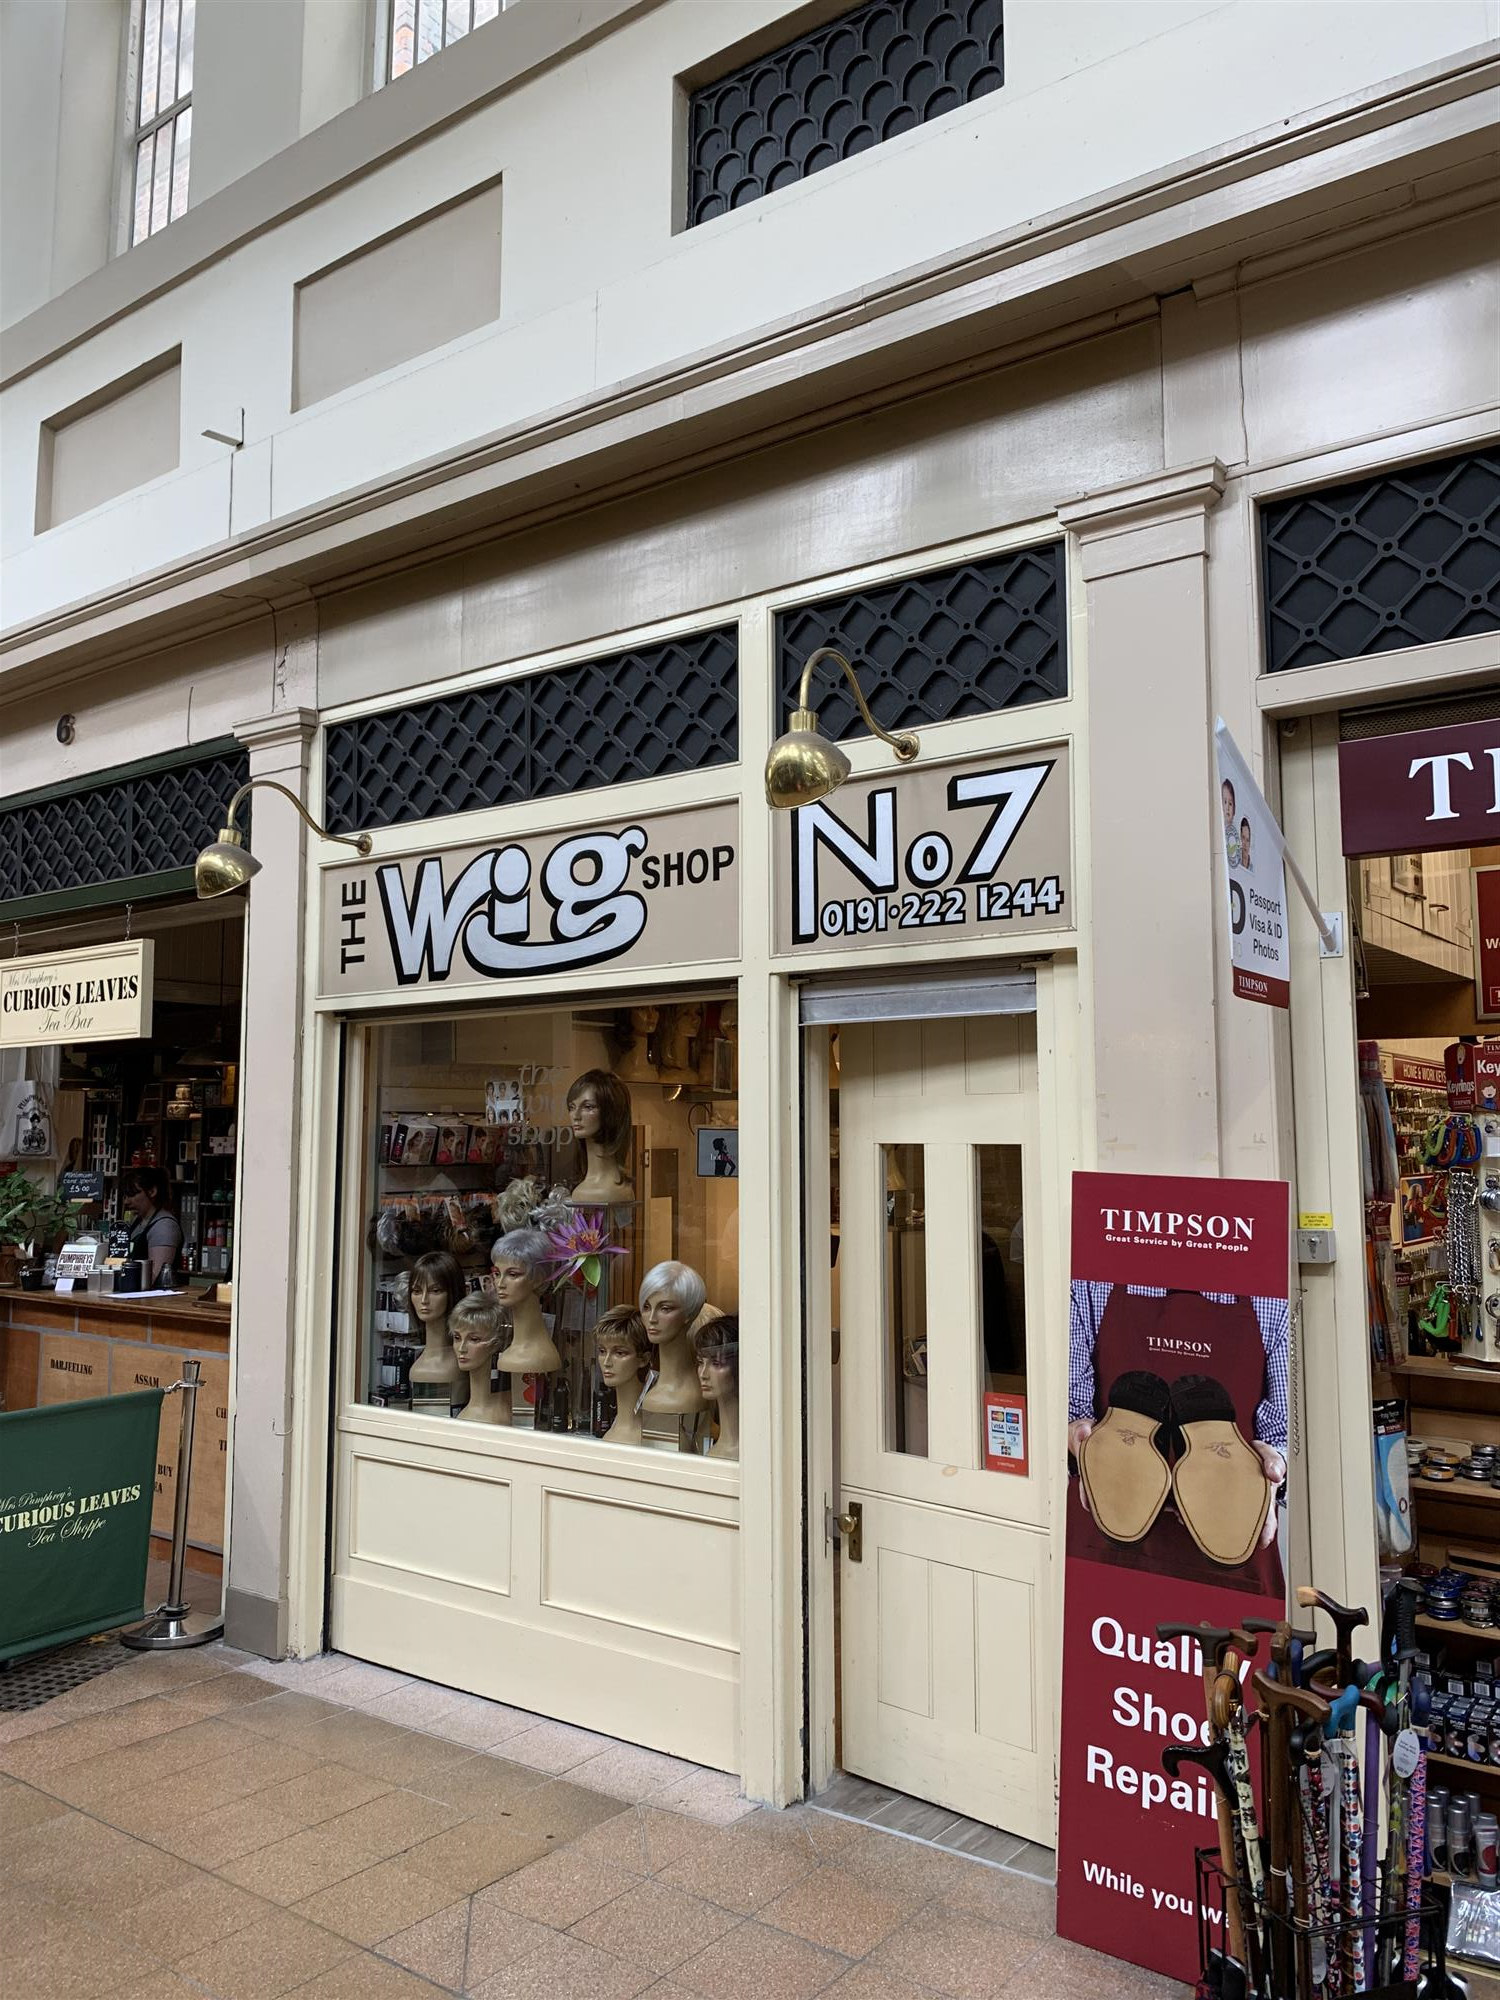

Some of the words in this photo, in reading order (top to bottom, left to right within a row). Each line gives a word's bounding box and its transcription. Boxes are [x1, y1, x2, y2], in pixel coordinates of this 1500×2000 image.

[57, 713, 76, 746] 6
[340, 879, 366, 974] THE
[376, 825, 648, 986] Wig
[641, 845, 735, 890] SHOP
[976, 875, 1064, 921] 1244
[1249, 888, 1282, 916] Passport
[1249, 913, 1266, 934] Visa
[1267, 920, 1273, 937] &
[1274, 923, 1283, 939] ID
[1253, 938, 1279, 961] Photos
[4, 984, 71, 1013] CURIOUS
[75, 975, 138, 1005] LEAVES
[1238, 975, 1268, 993] TIMPSON
[39, 1006, 61, 1033] Tea
[64, 1004, 94, 1031] Bar
[1403, 1064, 1417, 1079] HOME
[1447, 1079, 1475, 1096] Keyrings
[507, 1126, 573, 1152] shop
[1100, 1208, 1255, 1241] TIMPSON
[1105, 1234, 1131, 1243] Great
[1133, 1236, 1168, 1246] Service
[1171, 1239, 1183, 1248] by
[1186, 1240, 1212, 1249] Great
[1215, 1242, 1249, 1252] People
[1146, 1336, 1212, 1353] TIMPSON
[50, 1358, 93, 1376] DARJEELING
[134, 1373, 160, 1388] ASSAM
[157, 1463, 174, 1478] BUY
[0, 1500, 75, 1534] URIOUS
[79, 1484, 140, 1514] LEAVES
[18, 1486, 72, 1508] Pumphrey's
[27, 1522, 58, 1548] Tea
[60, 1516, 107, 1541] Shoppe
[1091, 1616, 1252, 1686] Quali
[1083, 1860, 1145, 1899] While
[1151, 1888, 1194, 1916] you
